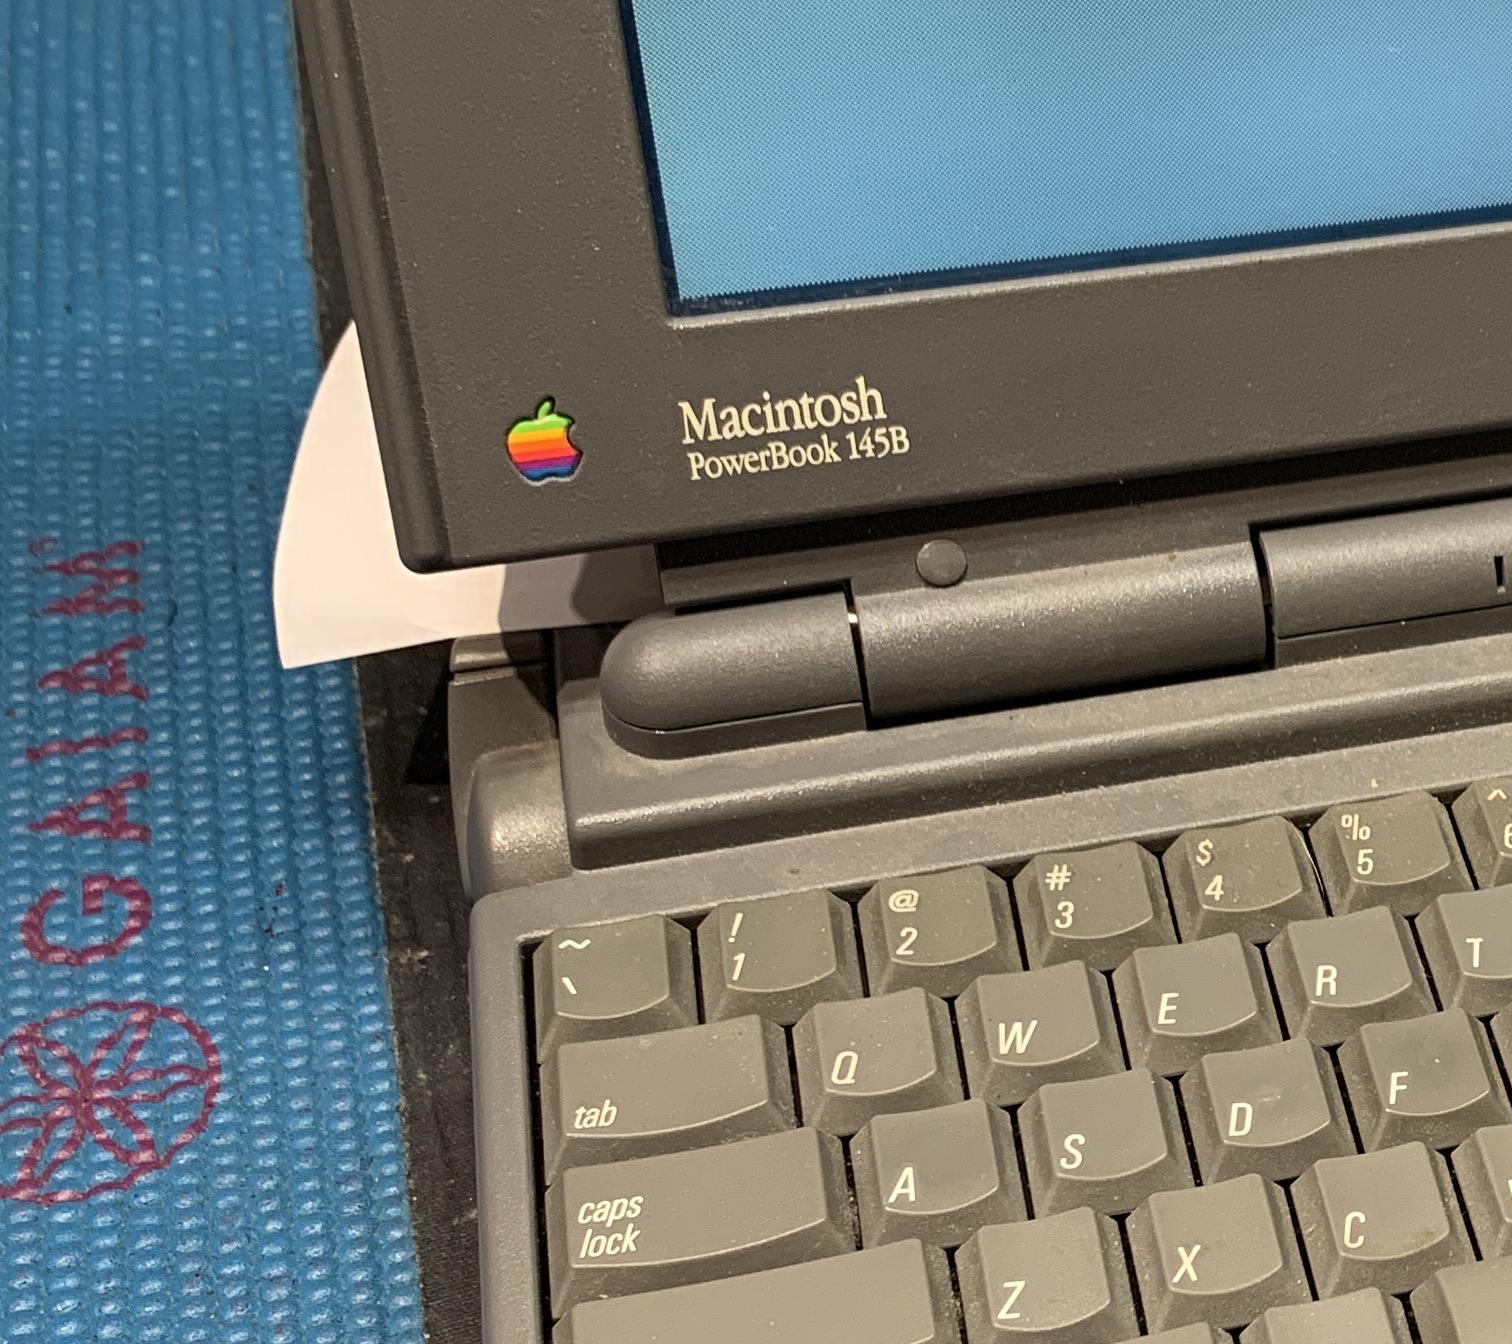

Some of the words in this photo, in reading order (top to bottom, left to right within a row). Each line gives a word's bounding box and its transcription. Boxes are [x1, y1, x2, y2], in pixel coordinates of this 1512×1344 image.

[677, 375, 887, 445] Macintosh
[687, 436, 842, 481] PowerBook
[844, 425, 910, 461] 145B
[20, 539, 152, 967] GAIAM
[1341, 813, 1371, 841] %
[1196, 838, 1214, 866] $
[1357, 849, 1375, 875] 5
[1045, 864, 1072, 891] #
[1204, 874, 1224, 901] 4
[887, 889, 920, 913] @
[1054, 901, 1075, 929] 3
[895, 927, 919, 956] 2
[1465, 937, 1484, 968] T
[732, 952, 746, 981] 1
[1315, 965, 1338, 997] R
[1157, 993, 1179, 1025] E
[998, 1020, 1038, 1055] W
[831, 1051, 859, 1085] Q
[1389, 1071, 1409, 1105] F
[574, 1099, 618, 1129] tab
[1228, 1102, 1254, 1137] D
[1059, 1133, 1086, 1170] S
[888, 1166, 916, 1203] A
[578, 1194, 645, 1229] caps
[579, 1223, 642, 1259] lock
[1343, 1211, 1366, 1249] C
[1171, 1245, 1201, 1284] X
[997, 1280, 1026, 1320] Z
